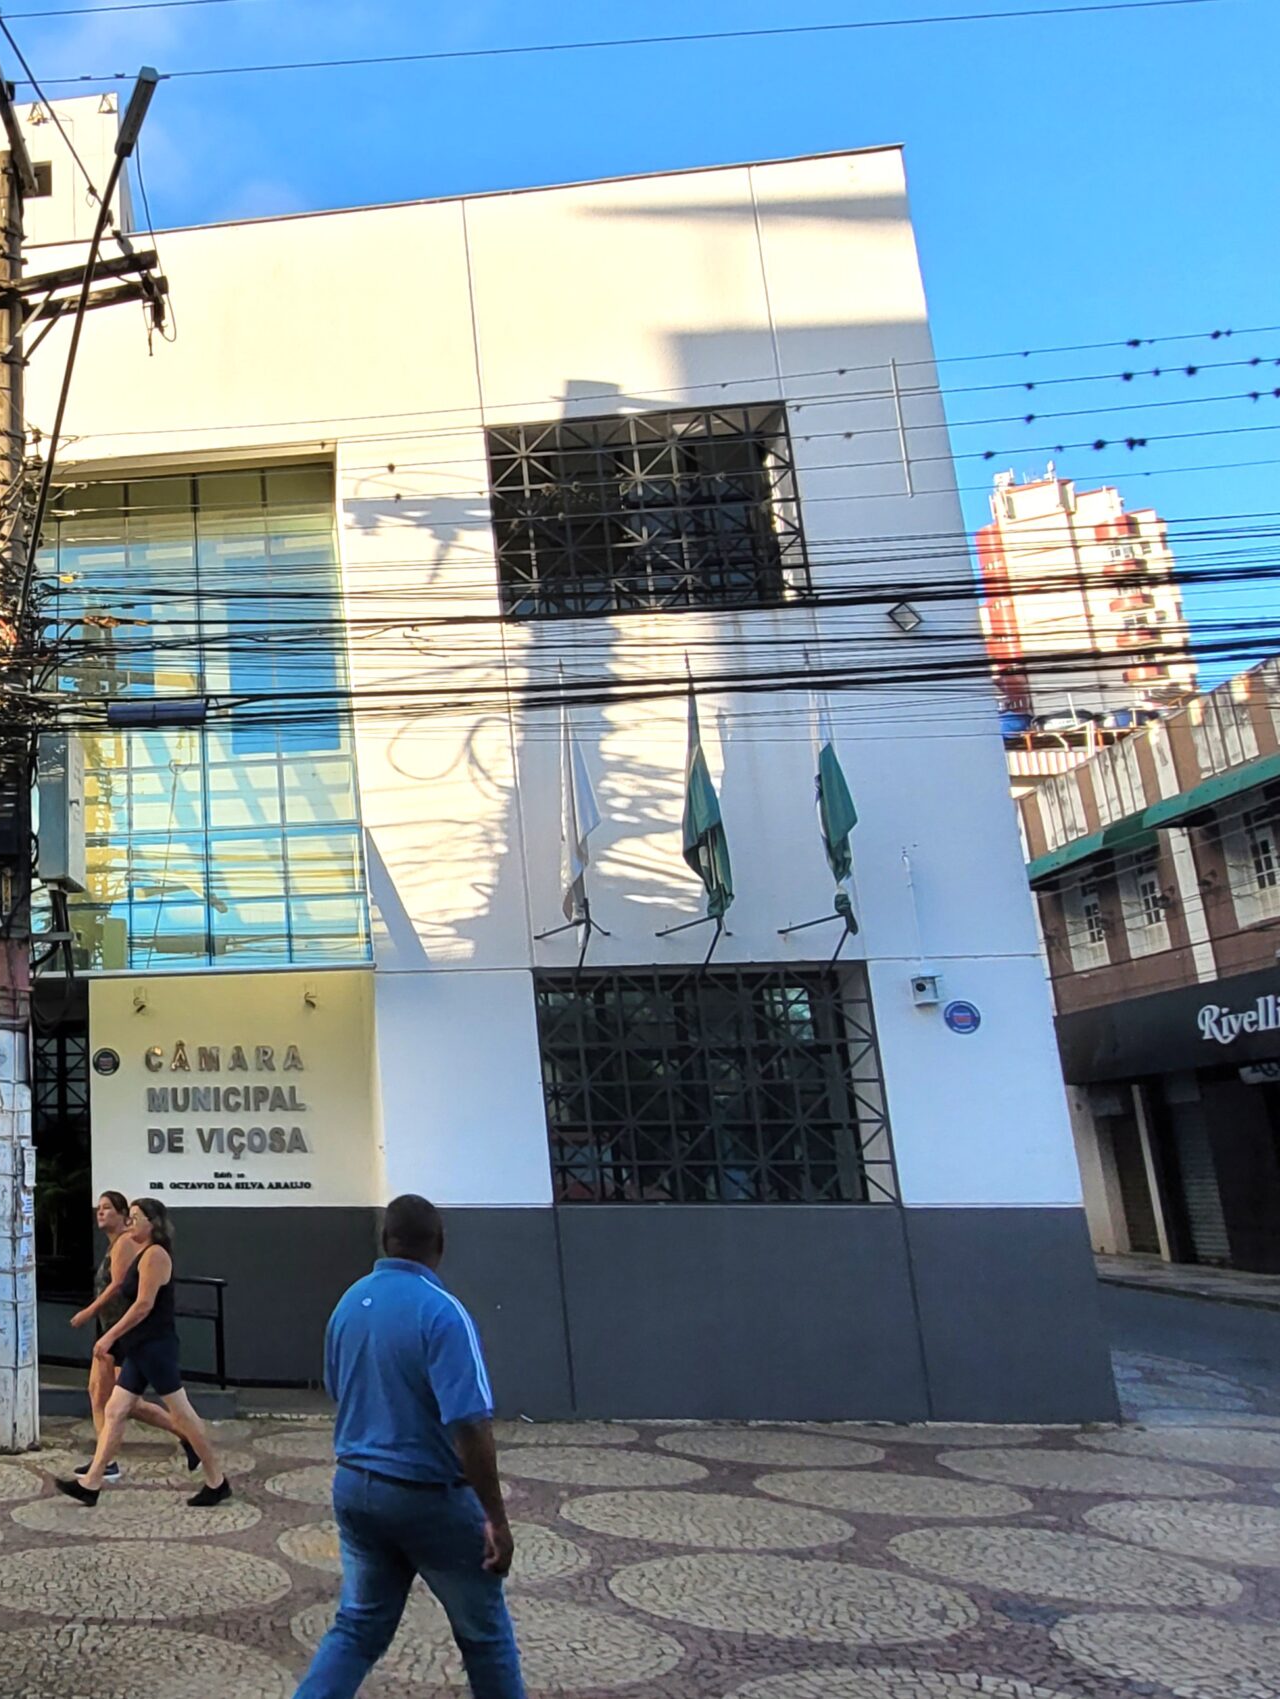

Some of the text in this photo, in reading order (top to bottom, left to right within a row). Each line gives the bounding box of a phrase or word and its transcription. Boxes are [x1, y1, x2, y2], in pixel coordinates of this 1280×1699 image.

[145, 1040, 304, 1072] CÂMARA
[147, 1086, 307, 1112] MUNICIPAL
[147, 1127, 308, 1159] DE VIÇOSA
[169, 1182, 215, 1190] OCTAVIO
[218, 1182, 232, 1190] DA
[235, 1182, 264, 1190] SILVA
